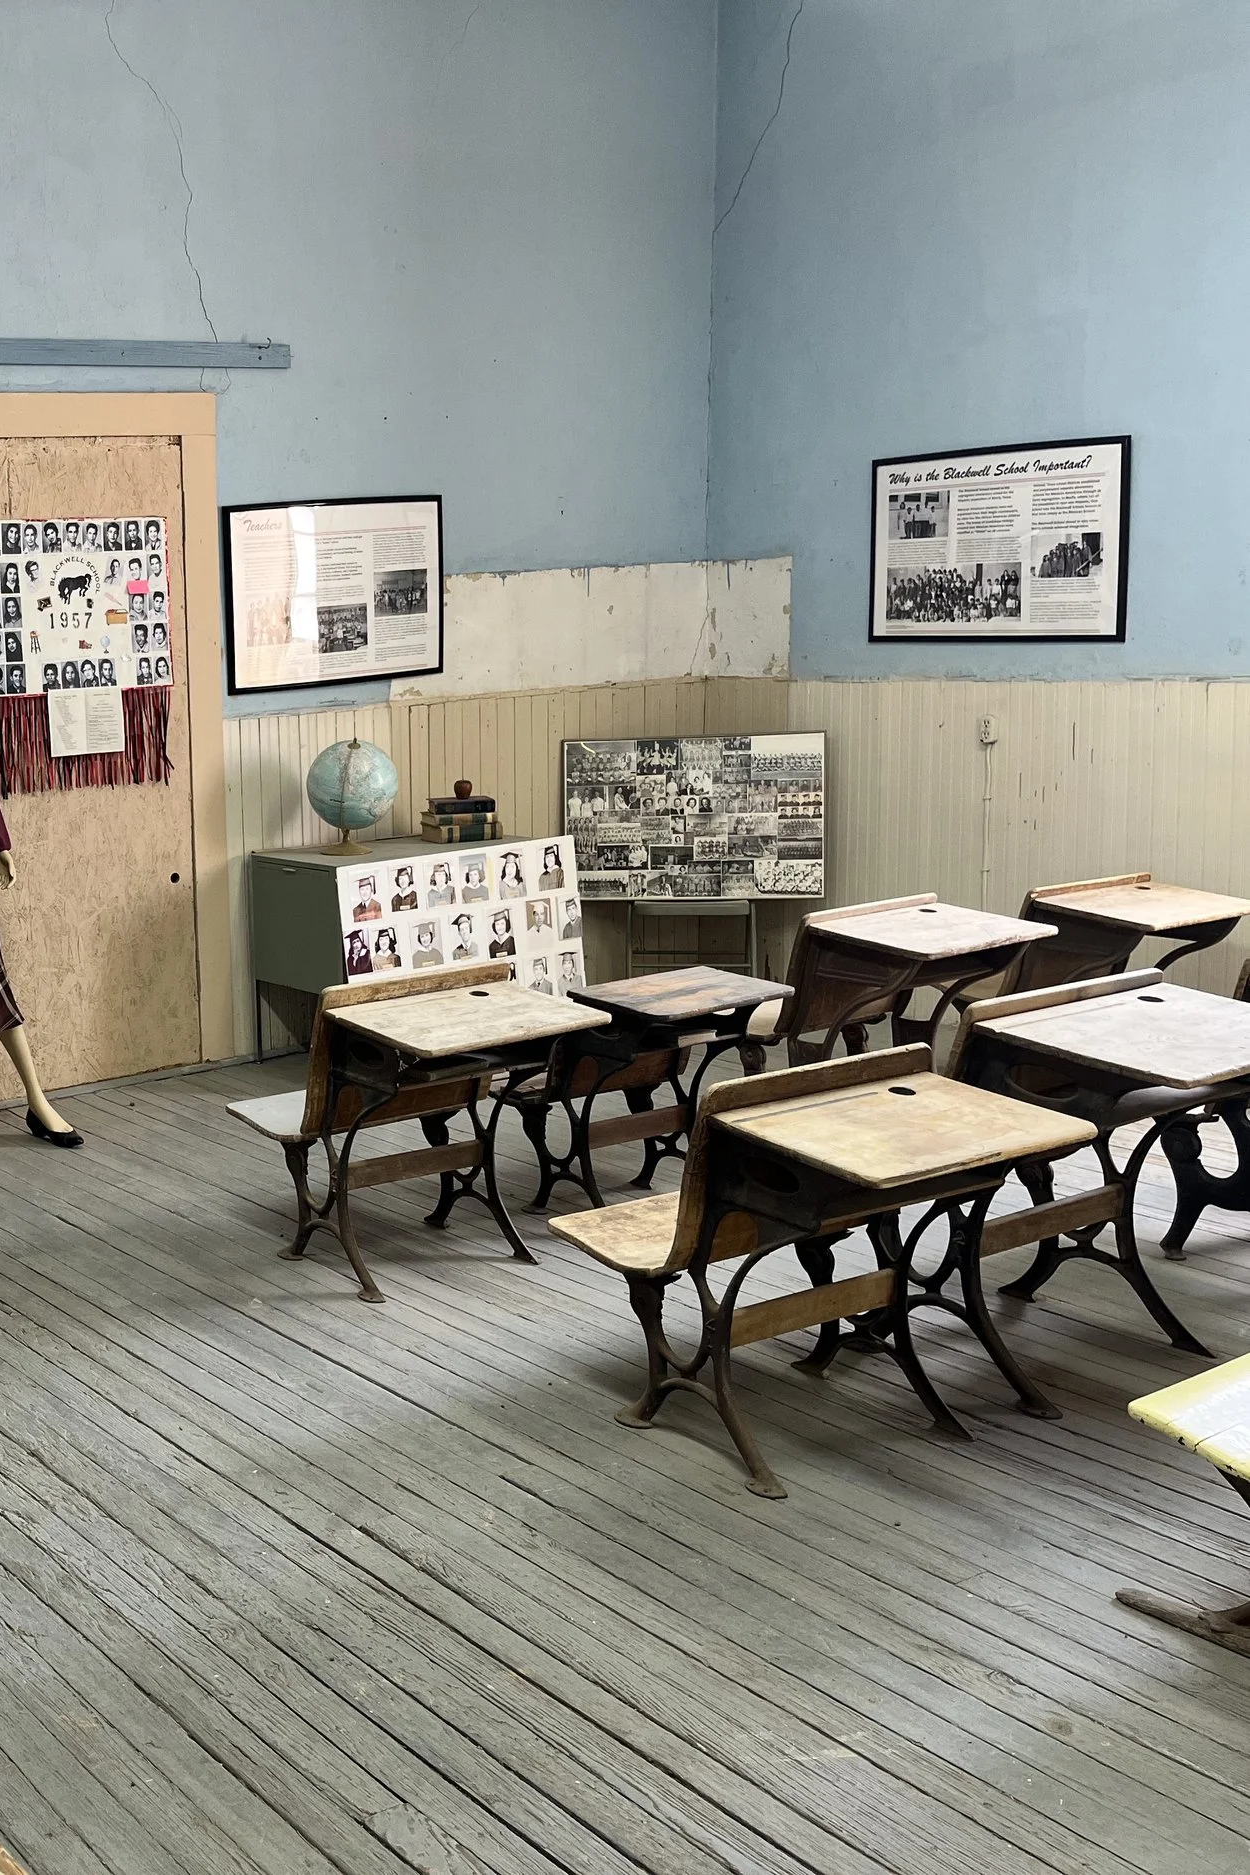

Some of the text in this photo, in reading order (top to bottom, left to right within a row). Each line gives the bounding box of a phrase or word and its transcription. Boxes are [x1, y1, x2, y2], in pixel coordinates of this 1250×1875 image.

[889, 455, 1093, 486] Why is the Blackwell School Important?
[243, 518, 282, 533] Teachers
[50, 556, 101, 594] BLACKWELL SCHOOL
[50, 612, 92, 629] 1957
